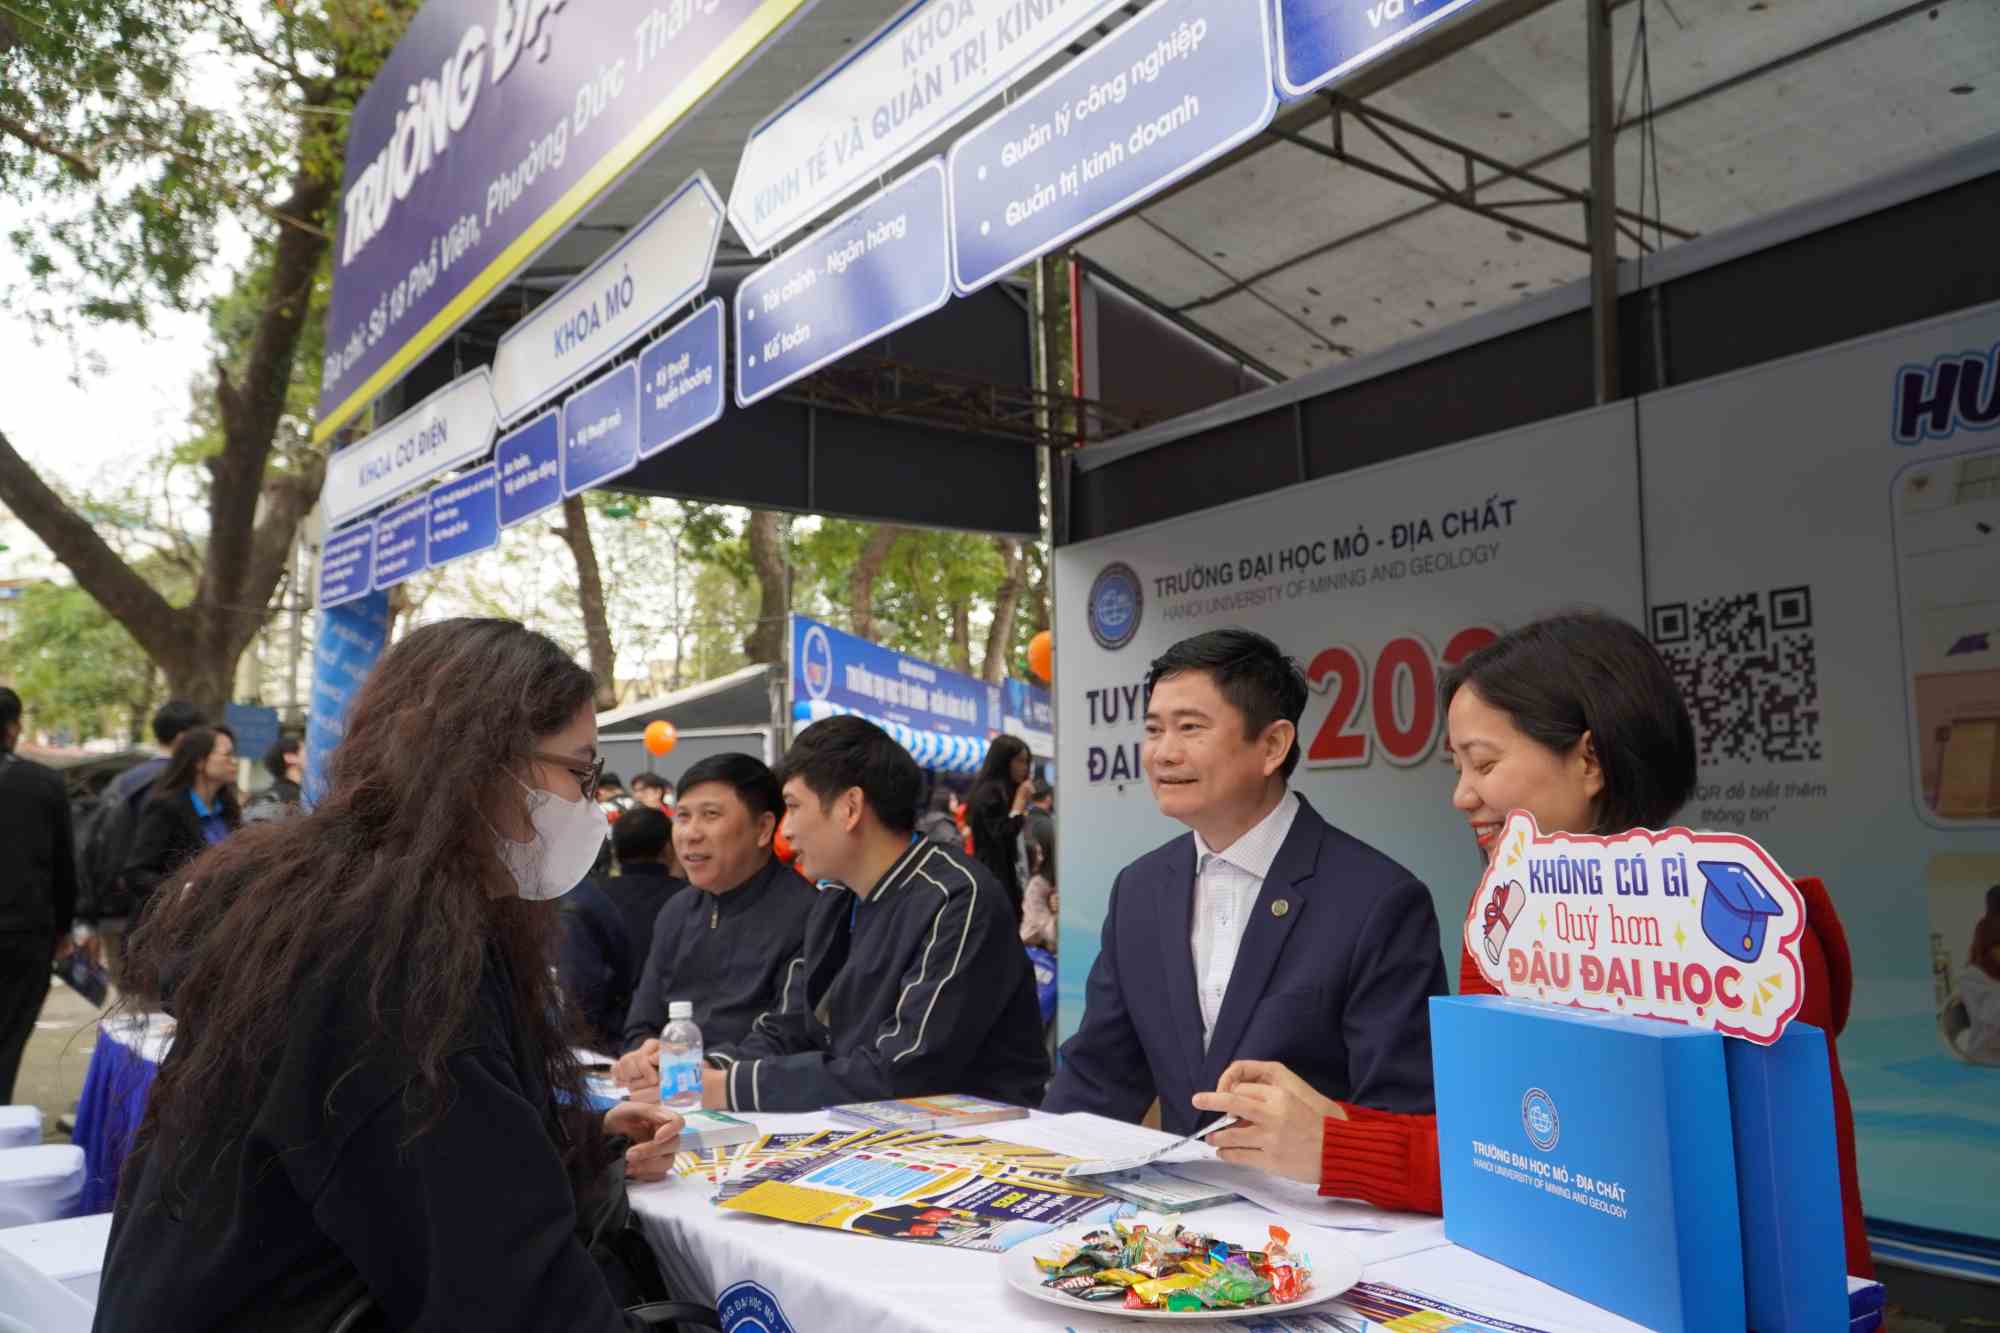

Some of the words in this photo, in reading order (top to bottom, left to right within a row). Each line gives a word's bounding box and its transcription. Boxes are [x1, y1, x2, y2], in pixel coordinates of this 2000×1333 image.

[834, 116, 865, 167] VÀ
[871, 64, 943, 140] QUẢN
[950, 29, 987, 85] TRỊ
[1001, 122, 1052, 168] Quản
[1054, 102, 1071, 136] lý
[1074, 71, 1128, 121] công
[1131, 18, 1208, 84] nghiệp
[342, 25, 485, 267] TRƯỜNG
[484, 117, 569, 228] Phường
[1005, 182, 1057, 227] Quản
[1060, 163, 1079, 197] trị
[1082, 140, 1125, 184] kinh
[1128, 94, 1201, 154] doanh
[827, 238, 865, 274] Ngân
[867, 213, 907, 251] hàng
[553, 300, 601, 359] KHOA
[604, 262, 634, 323] MỎ
[764, 330, 781, 363] Kế
[782, 322, 811, 354] toán
[1153, 561, 1234, 598] TRƯỜNG
[1239, 551, 1274, 582] ĐẠI
[1279, 540, 1327, 575] HỌC
[1333, 523, 1370, 561] MỎ
[1391, 518, 1435, 553] ĐỊA
[1441, 493, 1518, 540] CHẤT
[1205, 584, 1283, 617] UNIVERSITY
[1285, 578, 1306, 600] OF
[1310, 567, 1367, 594] MINING
[1369, 560, 1407, 583] AND
[1409, 542, 1501, 577] GEOLOGY
[1086, 671, 1152, 725] TUY
[1087, 742, 1141, 792] ĐẠI
[1528, 854, 1604, 895] KHÔNG
[1614, 852, 1649, 897] CÓ
[1661, 852, 1690, 898] GÌ
[1555, 901, 1600, 950] Quý
[1608, 903, 1664, 947] hơn
[1507, 940, 1572, 996] ĐẬU
[1580, 954, 1646, 1006] ĐẠI
[1653, 960, 1746, 1017] HỌC
[1472, 1139, 1511, 1165] TRƯỜNG
[1511, 1152, 1528, 1171] ĐẠI
[1529, 1158, 1552, 1178] HỌC
[1552, 1164, 1570, 1184] MỎ
[1576, 1173, 1595, 1194] ĐỊA
[1596, 1180, 1627, 1203] CHẤT
[1534, 1175, 1545, 1190] OF
[1589, 1196, 1628, 1219] GEOLOGY
